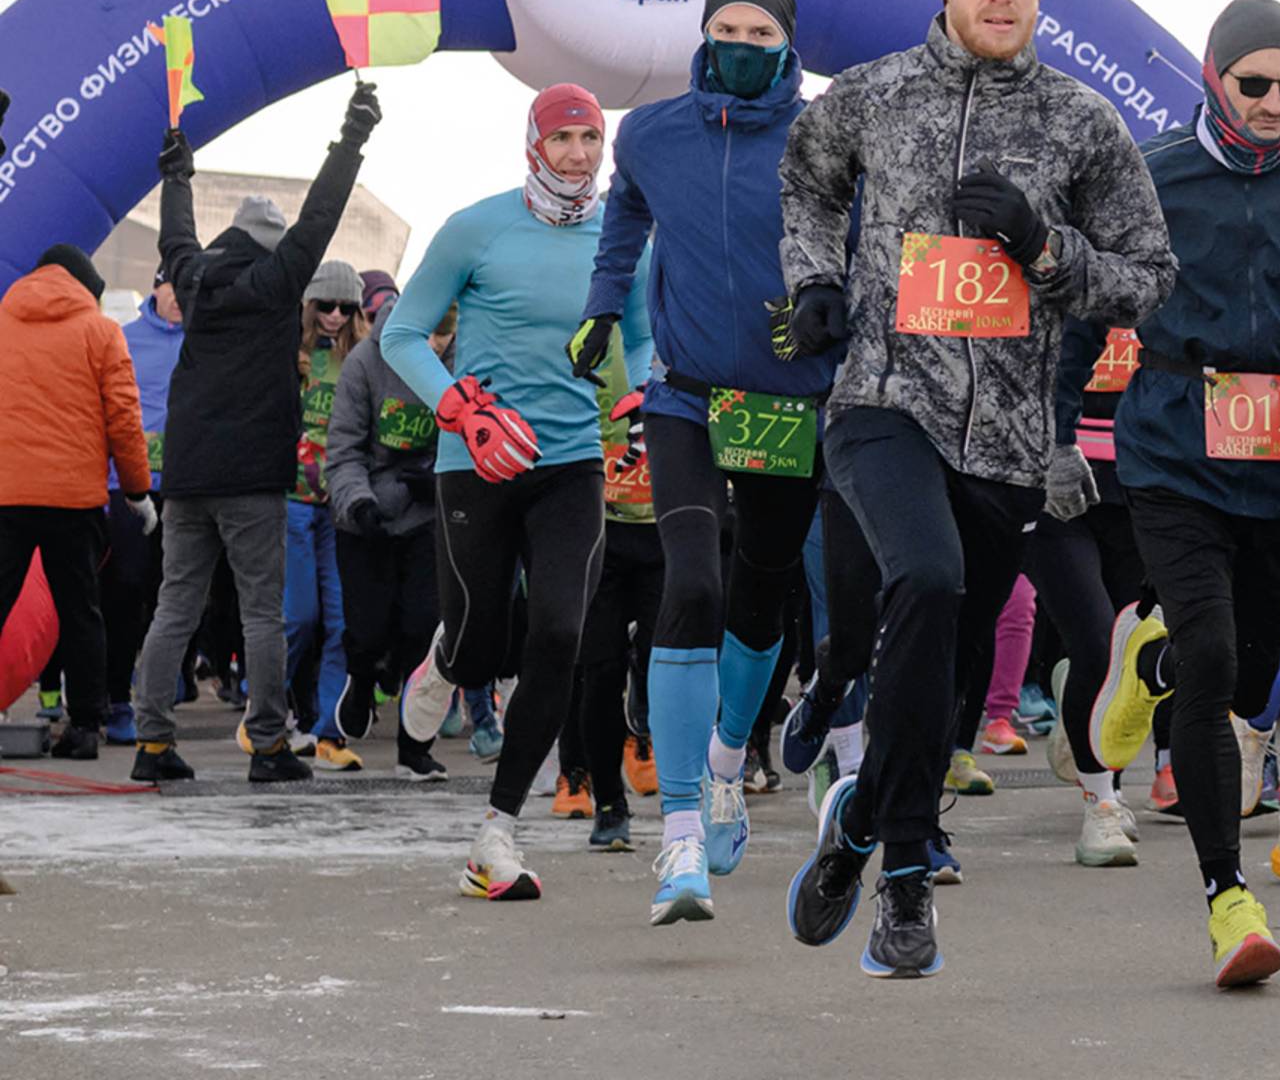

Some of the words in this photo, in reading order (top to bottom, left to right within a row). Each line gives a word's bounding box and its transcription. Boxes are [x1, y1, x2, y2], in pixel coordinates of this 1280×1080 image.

[1036, 10, 1182, 133] РАСНОДА
[929, 259, 1010, 305] 182
[906, 314, 952, 331] ЗАБЕГ
[1095, 343, 1135, 372] 44
[309, 389, 334, 412] 48
[391, 411, 434, 438] 340
[728, 409, 802, 448] 377
